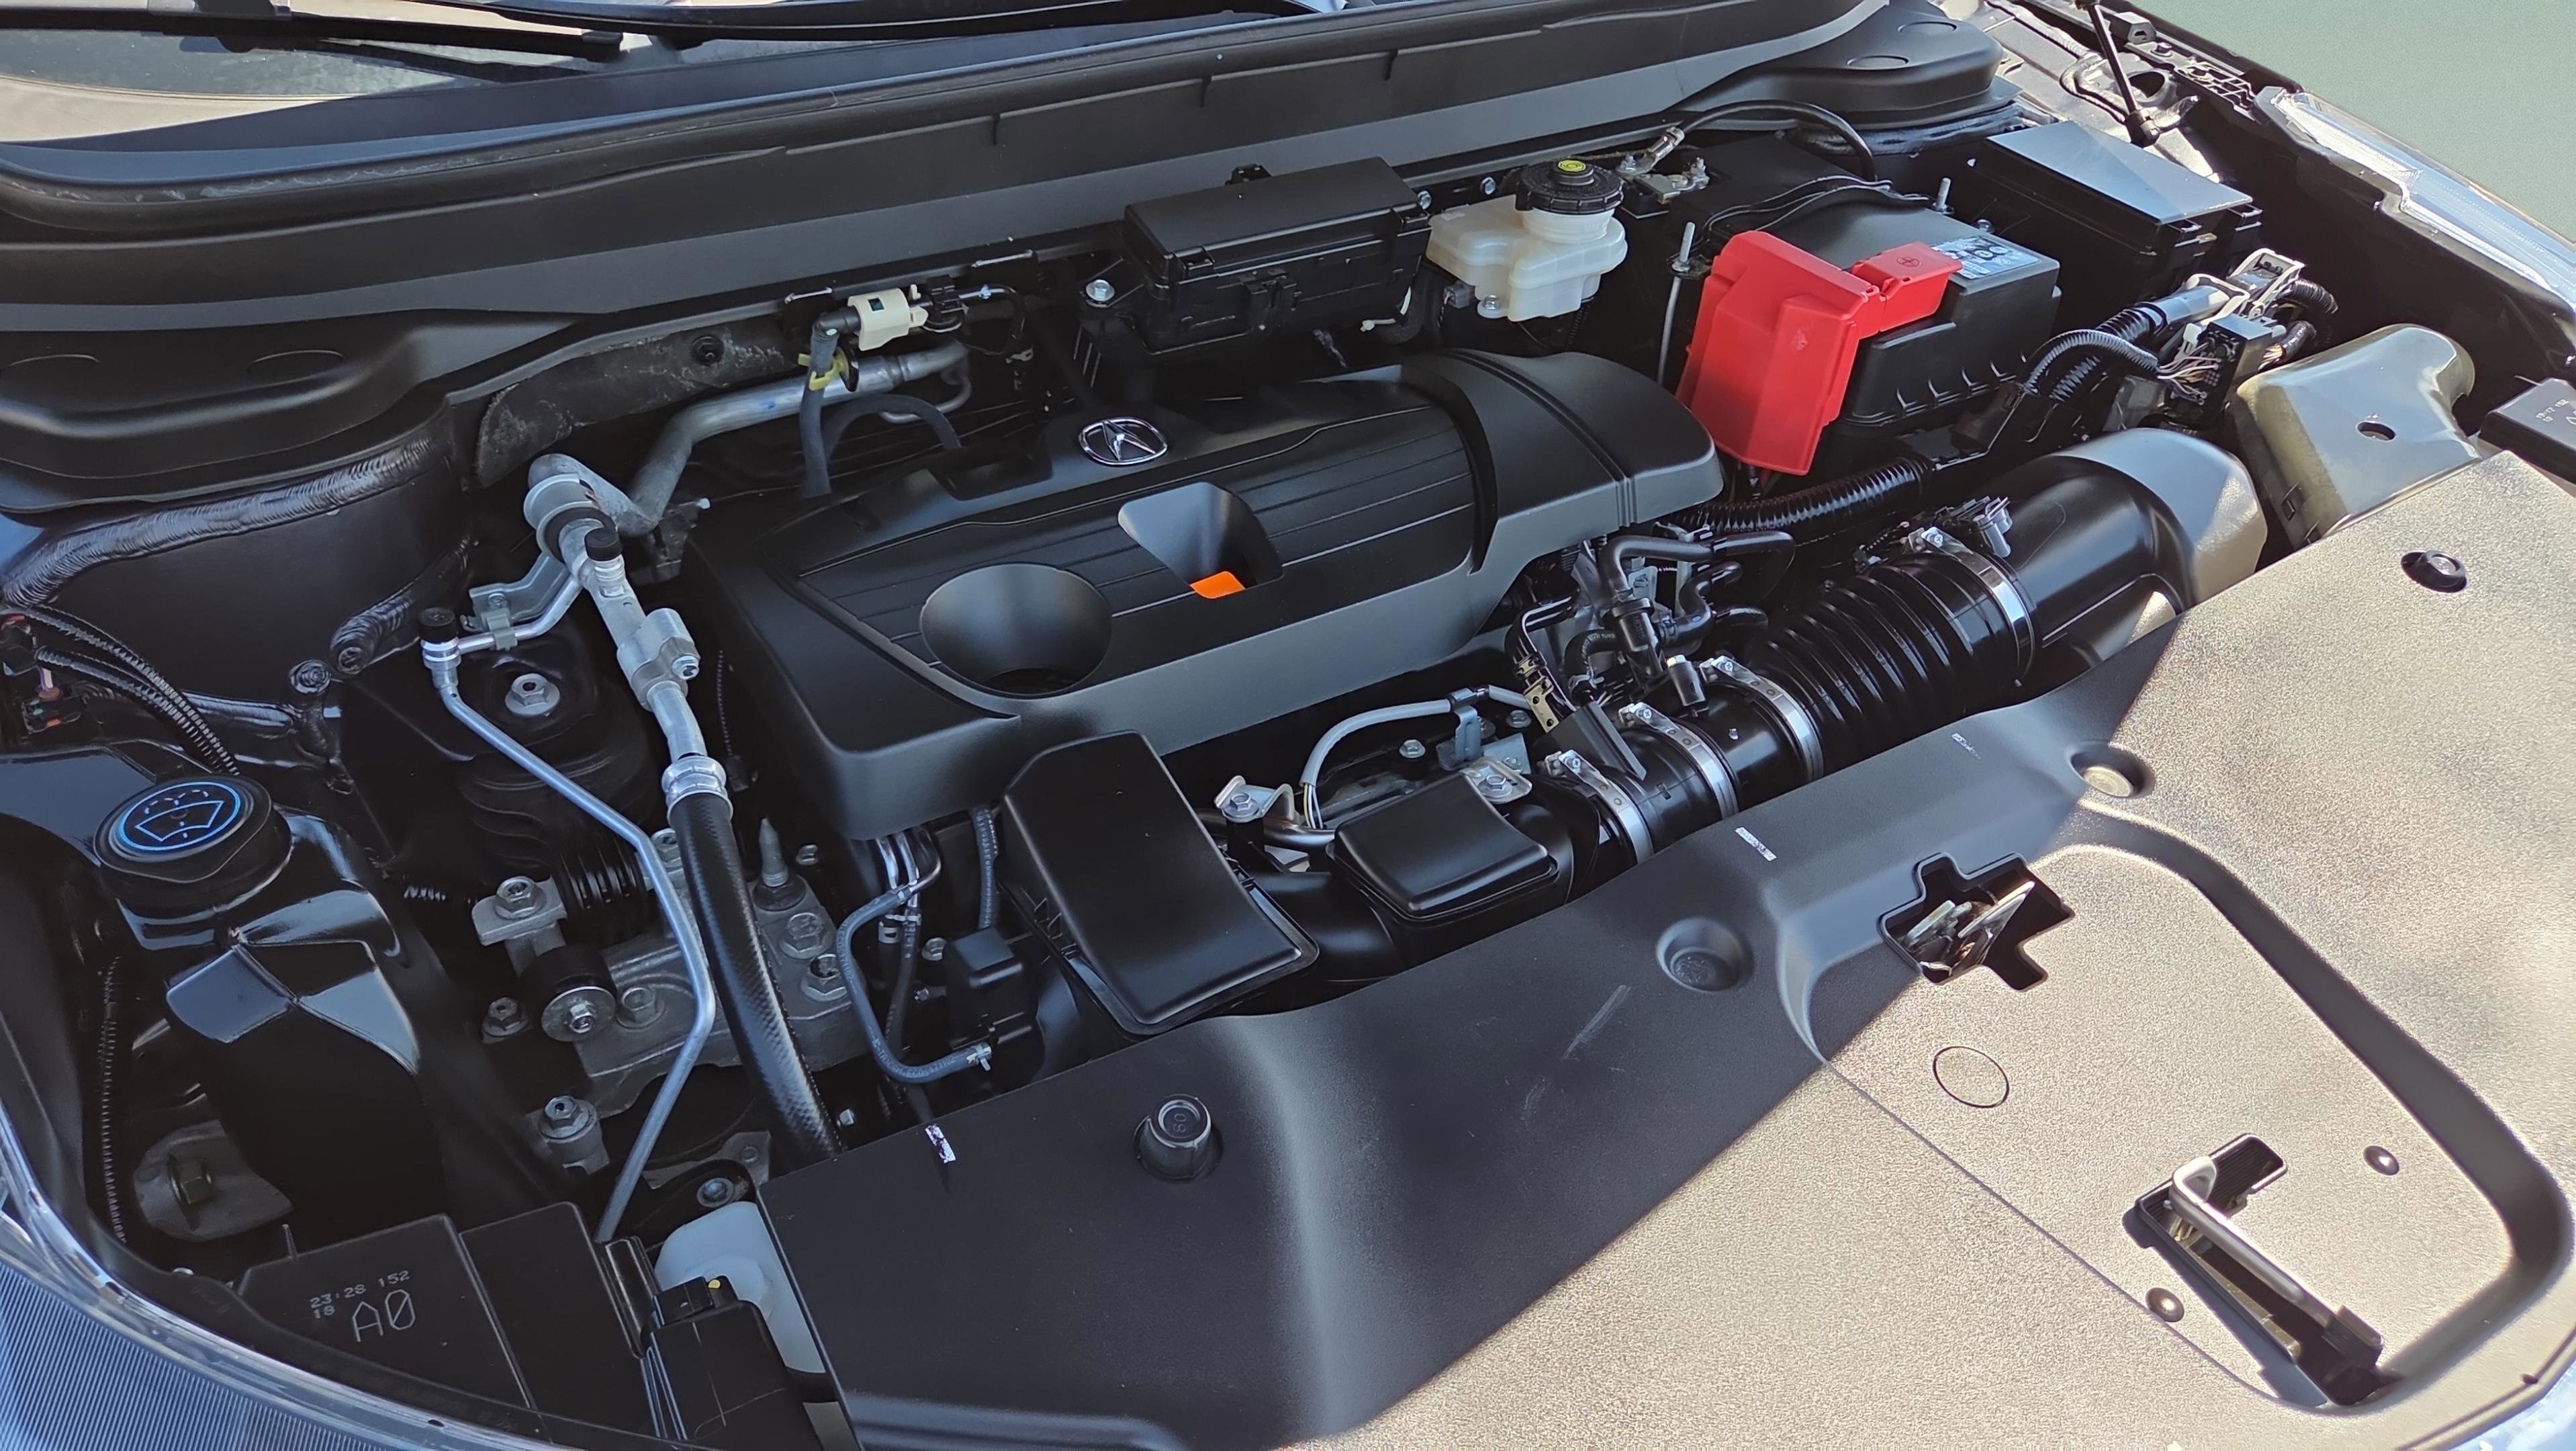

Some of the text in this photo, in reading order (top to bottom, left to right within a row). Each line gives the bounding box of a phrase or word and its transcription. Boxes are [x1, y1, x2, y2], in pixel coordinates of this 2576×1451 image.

[310, 1270, 410, 1309] 23:28 152
[314, 1305, 335, 1319] 18
